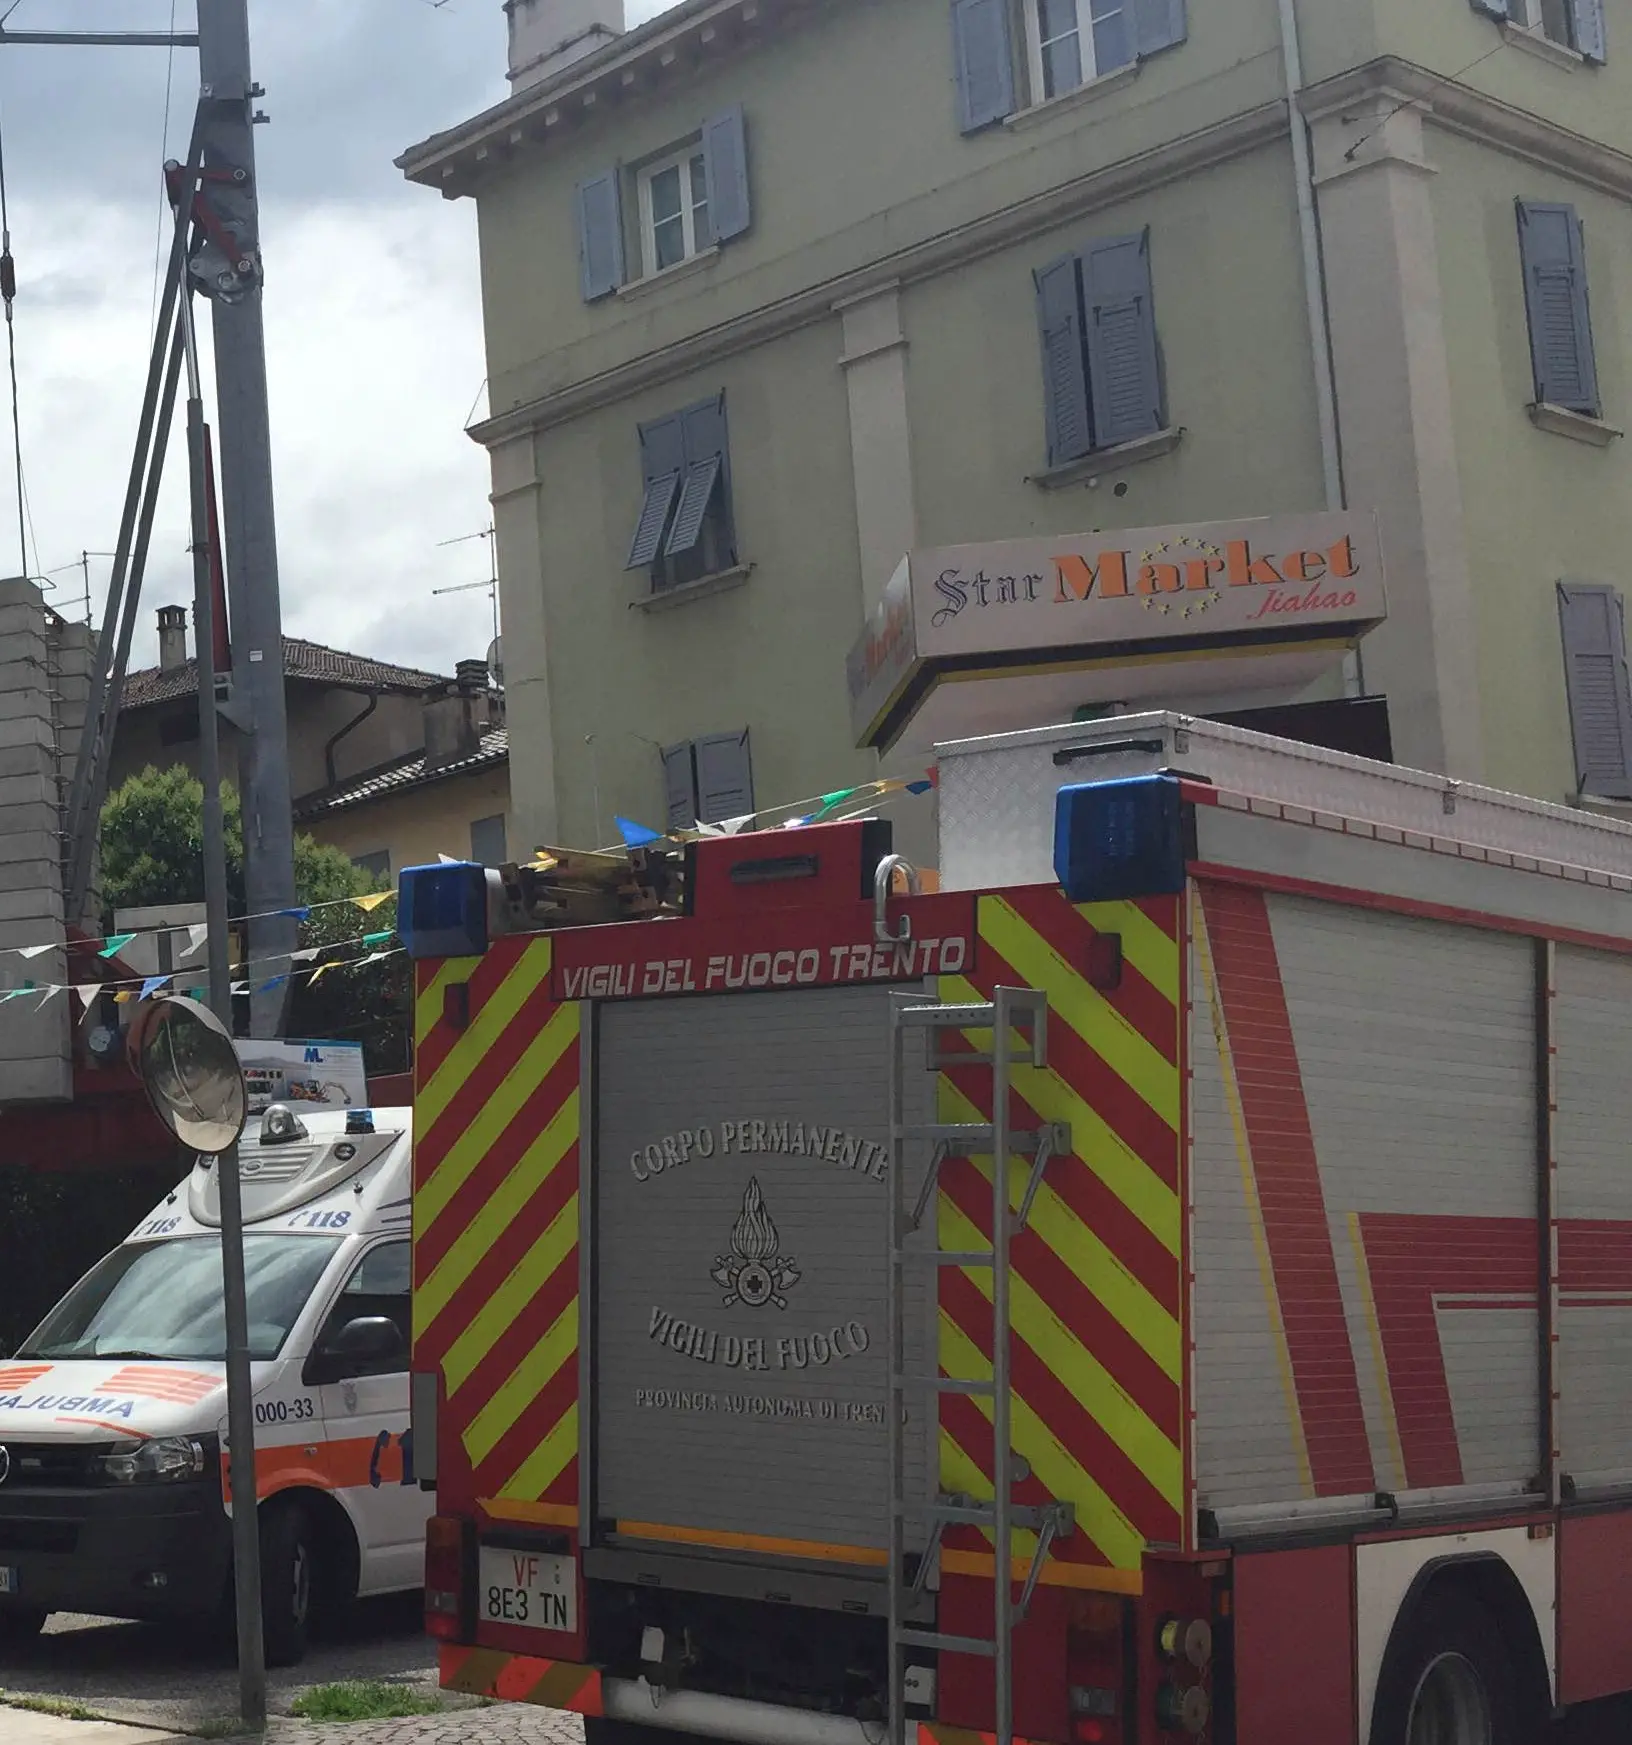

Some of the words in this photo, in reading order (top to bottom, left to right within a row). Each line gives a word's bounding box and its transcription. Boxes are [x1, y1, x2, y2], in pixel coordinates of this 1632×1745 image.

[930, 569, 1045, 628] Star
[1050, 534, 1361, 603] Market
[1247, 582, 1358, 620] Jiahao
[562, 963, 635, 999] VIGILI
[642, 958, 696, 994] DEL
[705, 949, 820, 988] FUOCO
[829, 937, 966, 980] TRENTO
[629, 1125, 715, 1182] CORPO
[720, 1120, 889, 1182] PERMANENTE
[145, 1215, 182, 1235] 118
[304, 1210, 351, 1228] 118
[648, 1305, 719, 1363] VIGILI
[724, 1335, 771, 1370] DEL
[776, 1320, 870, 1369] FUOCO
[635, 1387, 719, 1411] PROVINCIA
[819, 1401, 838, 1419] DI
[513, 1555, 539, 1587] VF
[488, 1586, 529, 1621] 8E3
[539, 1591, 567, 1627] TN
